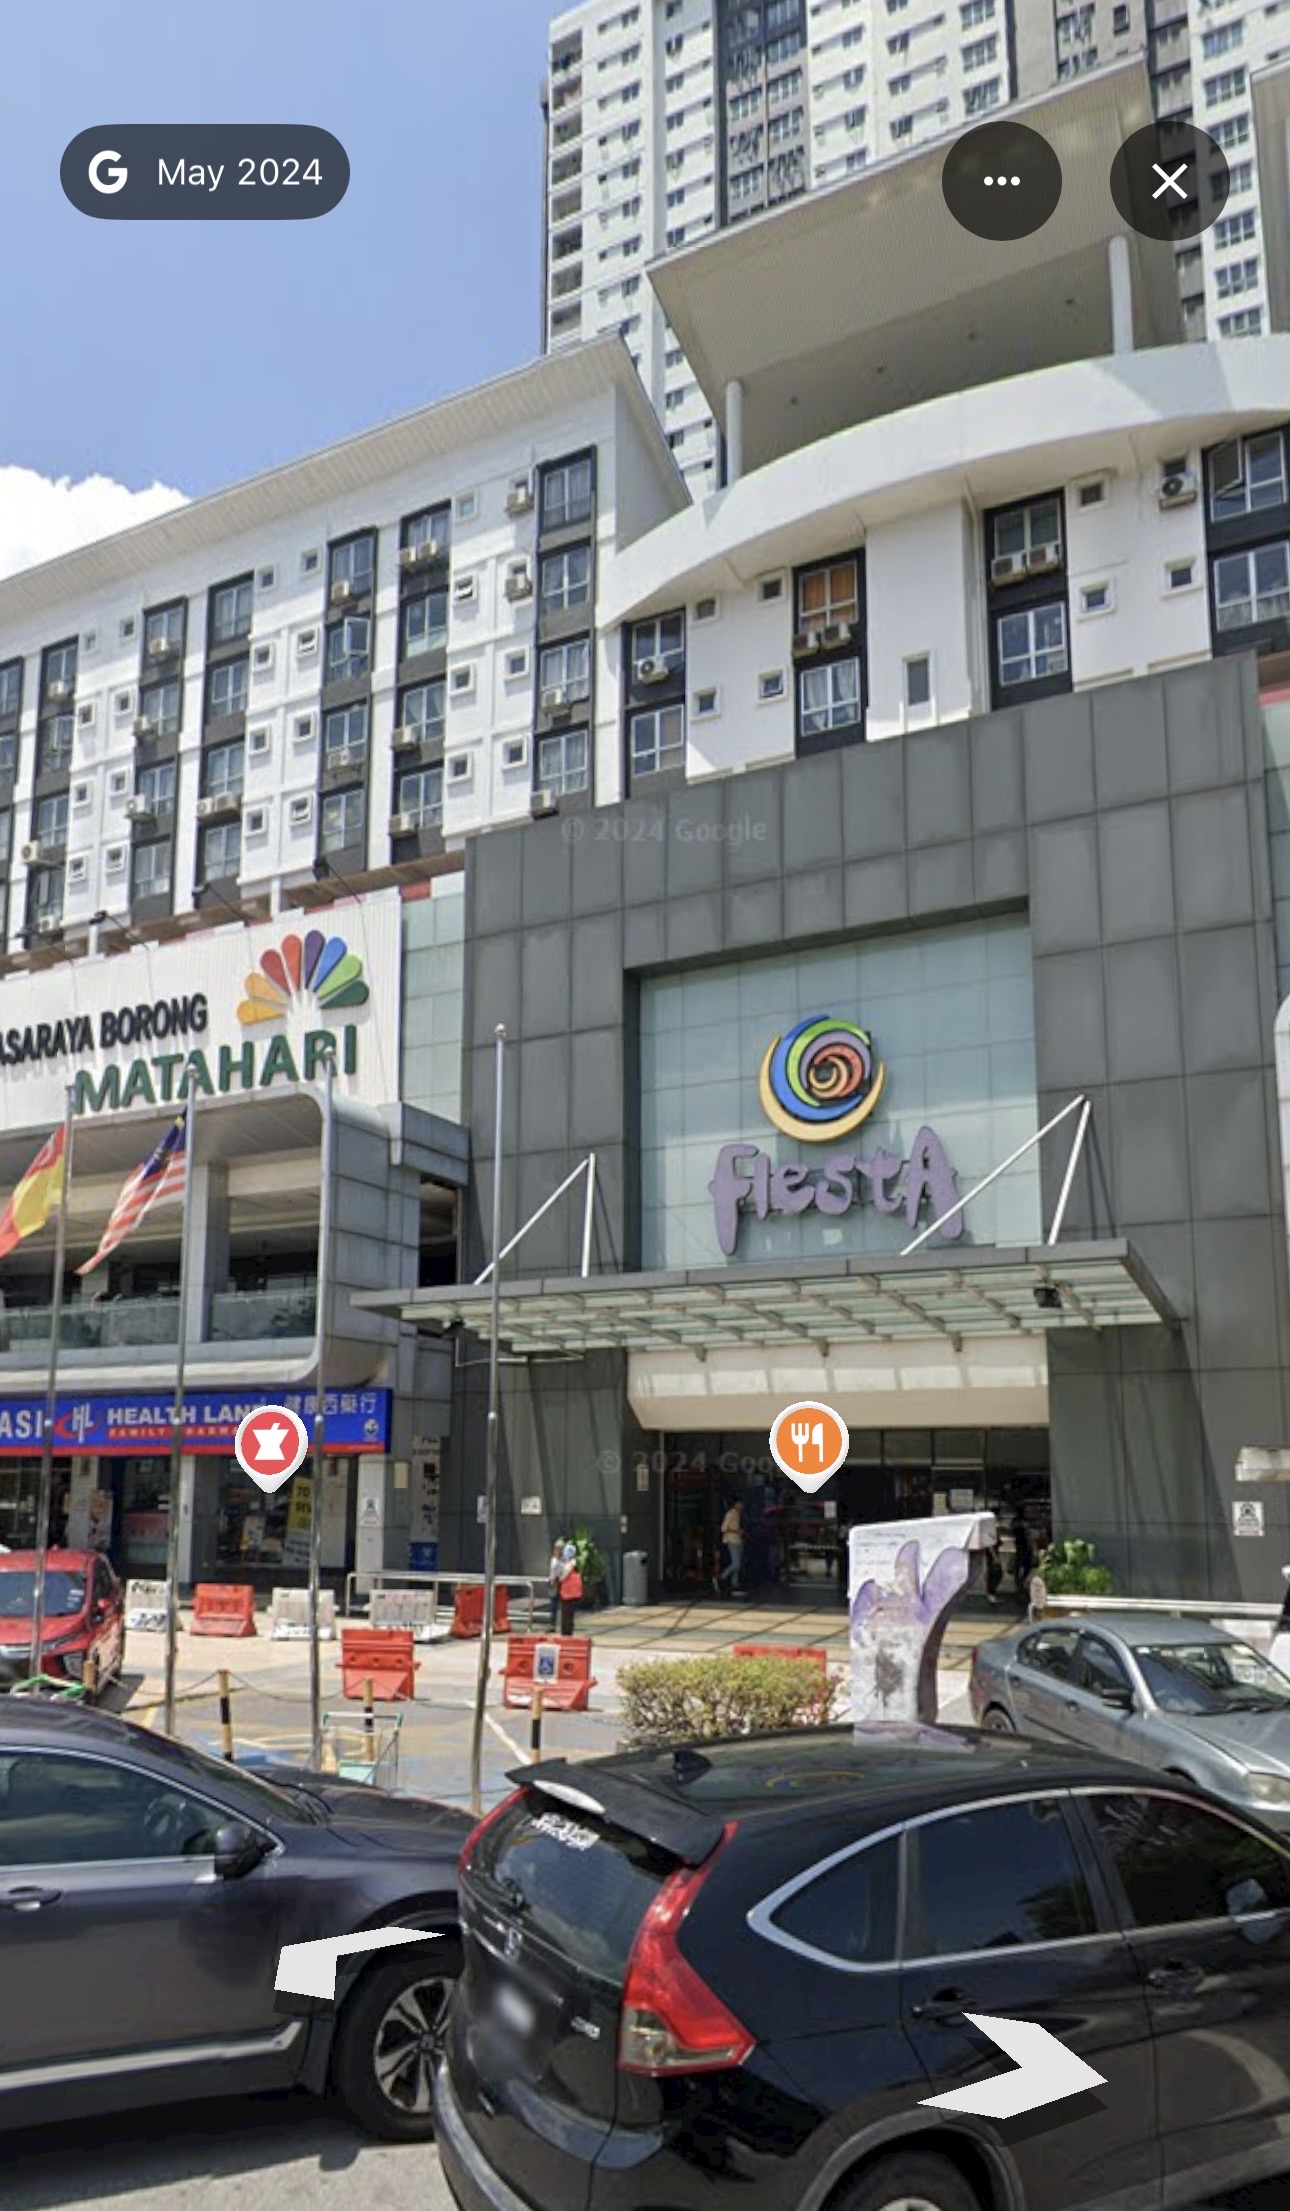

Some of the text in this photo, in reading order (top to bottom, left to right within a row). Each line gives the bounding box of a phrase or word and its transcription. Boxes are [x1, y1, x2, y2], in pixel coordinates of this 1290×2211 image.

[100, 993, 208, 1049] BORONG
[74, 1025, 358, 1114] MATAHARI
[107, 1404, 258, 1426] HEALTH LAN
